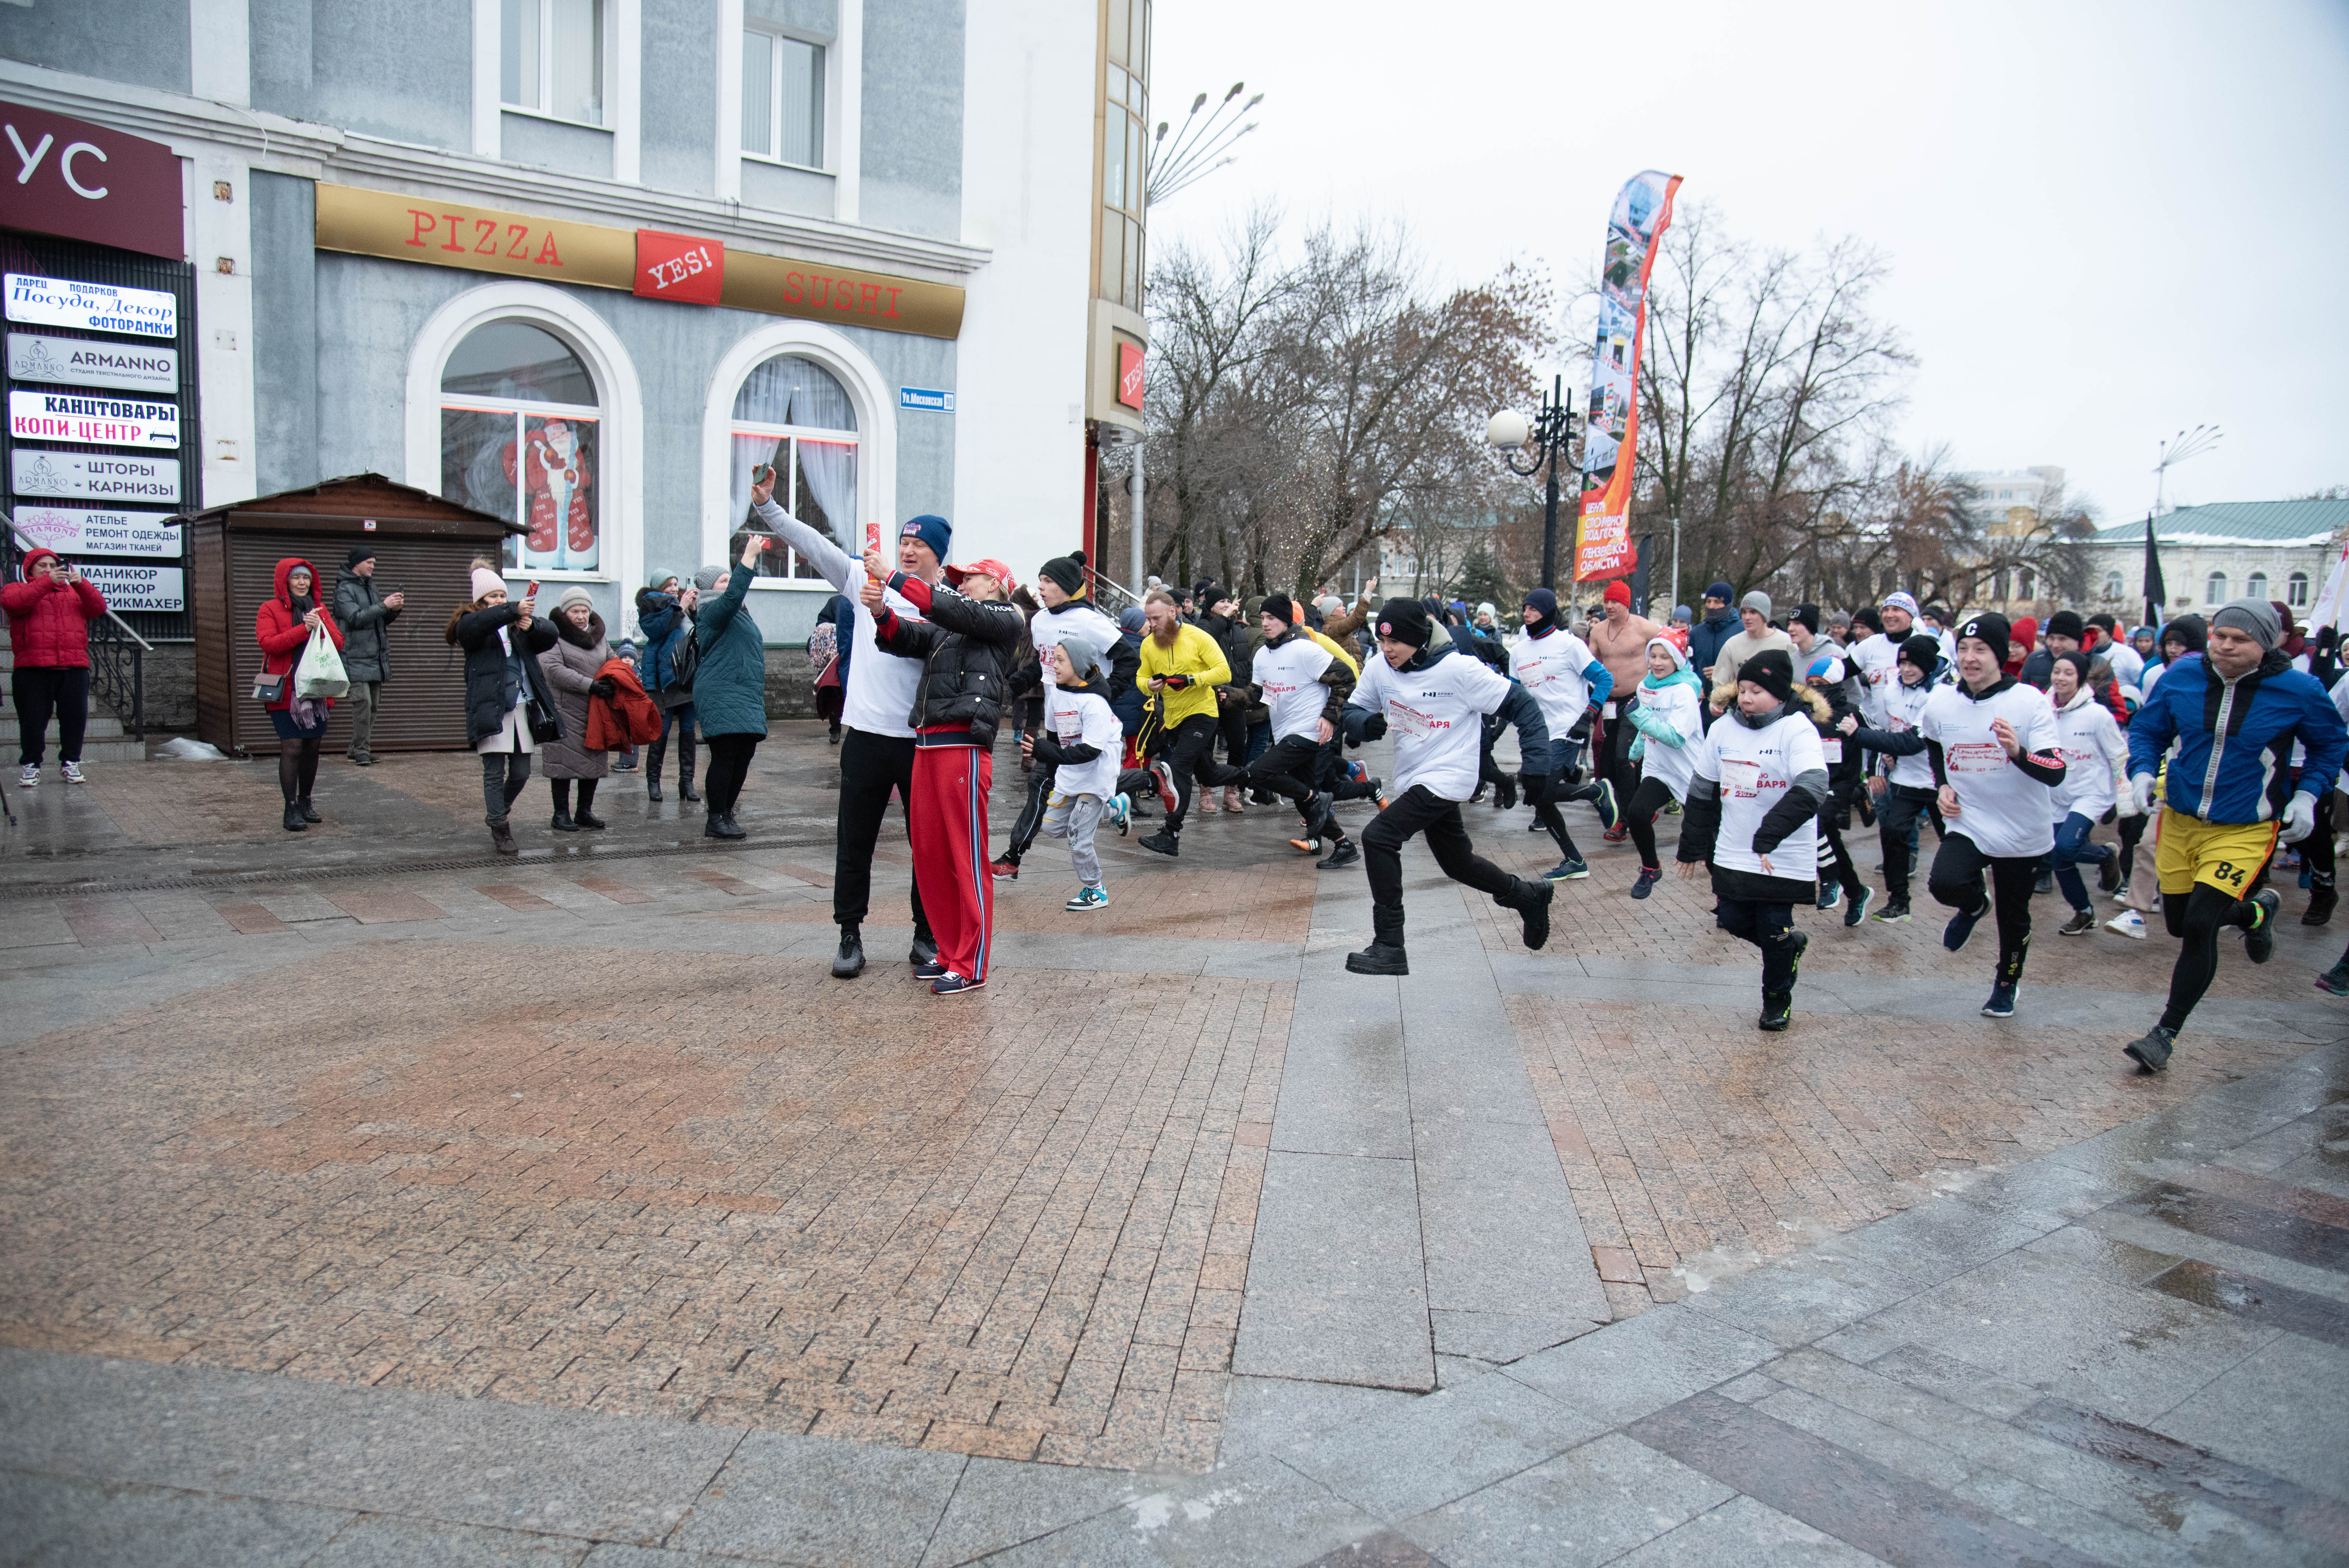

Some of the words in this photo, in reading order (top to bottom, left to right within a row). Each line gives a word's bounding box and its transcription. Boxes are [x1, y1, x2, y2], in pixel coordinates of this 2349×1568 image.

[5, 124, 108, 200] УС
[405, 209, 563, 266] PIZZA
[648, 246, 713, 289] YES!
[16, 278, 47, 289] ЛАРЕЦ
[70, 284, 118, 297] ПОДАРКОВ
[784, 272, 903, 318] SUSHI
[12, 287, 100, 312] Посуда,
[106, 299, 172, 321] Декор
[89, 315, 173, 335] ФОТОРАМКИ
[70, 351, 171, 372] ARMANNO
[96, 370, 142, 379] ТЕКСТИЛЬНОГО
[45, 397, 175, 422] КАНЦТОВАРЫ
[15, 416, 141, 442] КОПИ-ЦЕНТР
[88, 461, 155, 476] ШТОРЫ
[89, 481, 174, 496] КАРНИЗЫ
[86, 515, 128, 526] АТЕЛЬЕ
[23, 526, 77, 538] DIAMOND
[86, 529, 129, 538] РЕМОНТ
[132, 531, 179, 542] ОДЕЖДЫ
[569, 526, 578, 534] YES
[579, 529, 588, 538] YES
[86, 542, 127, 551] МАГАЗИН
[130, 543, 162, 552] ТКАНЕЙ
[572, 540, 581, 549] YES
[80, 568, 157, 580] МАНИКЮР
[105, 598, 182, 609] РИКМАХЕР
[2214, 862, 2246, 887] 84
